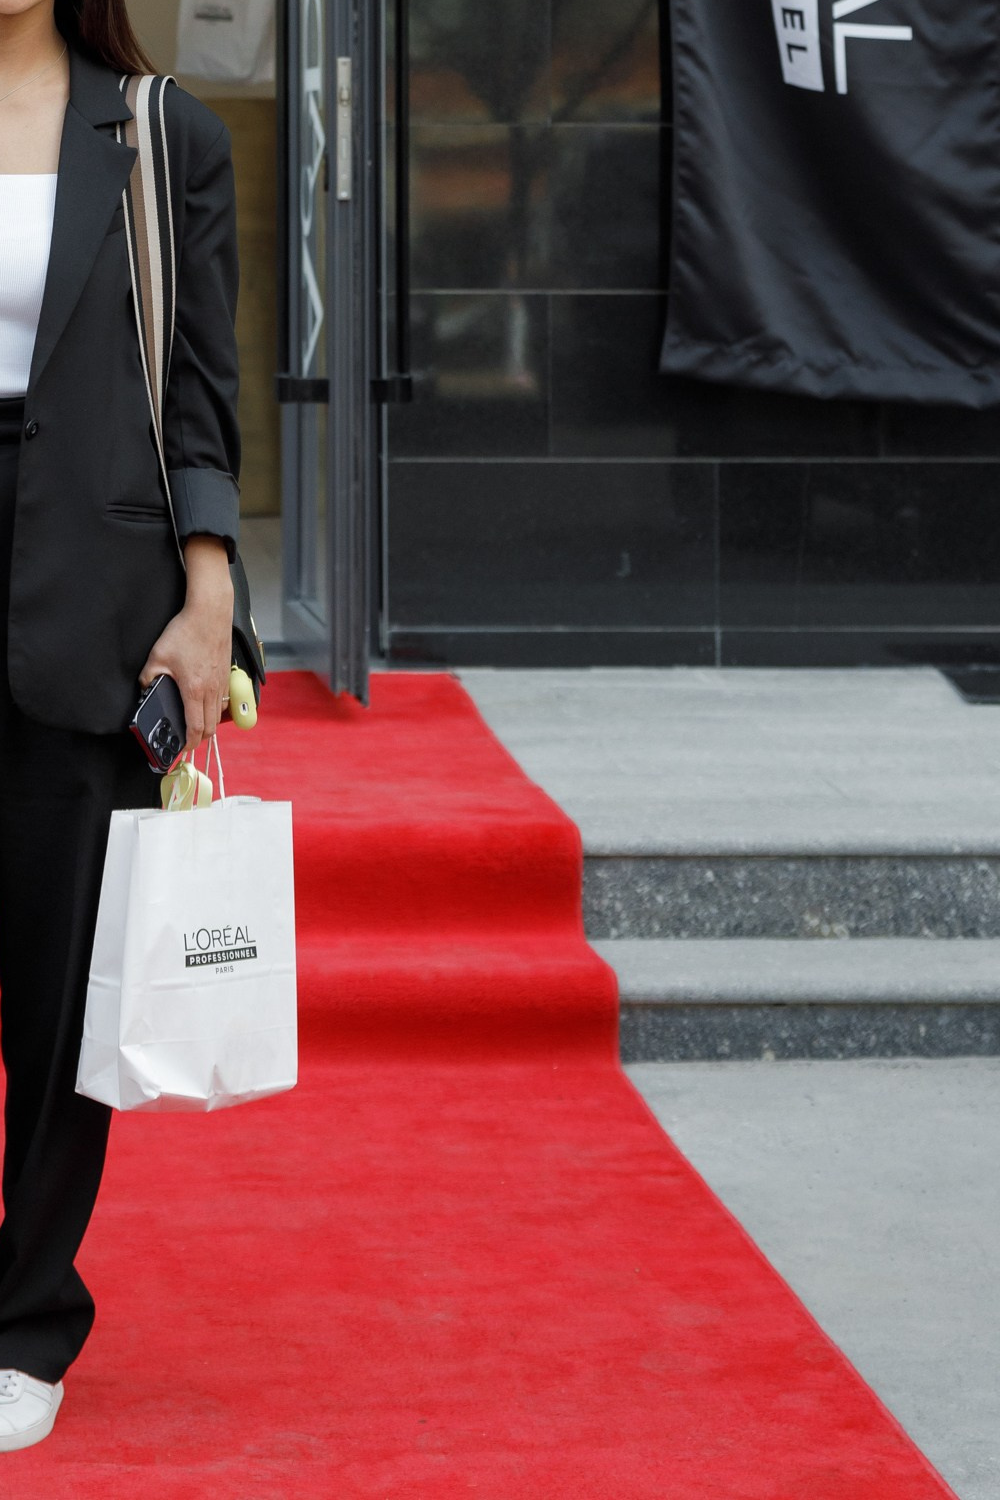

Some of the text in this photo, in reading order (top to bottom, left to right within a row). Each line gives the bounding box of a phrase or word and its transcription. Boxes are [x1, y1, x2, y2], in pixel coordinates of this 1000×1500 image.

[183, 925, 257, 951] L'ORÉAL
[189, 947, 255, 966] PROFESSIONNEL
[215, 965, 234, 974] PARIS
